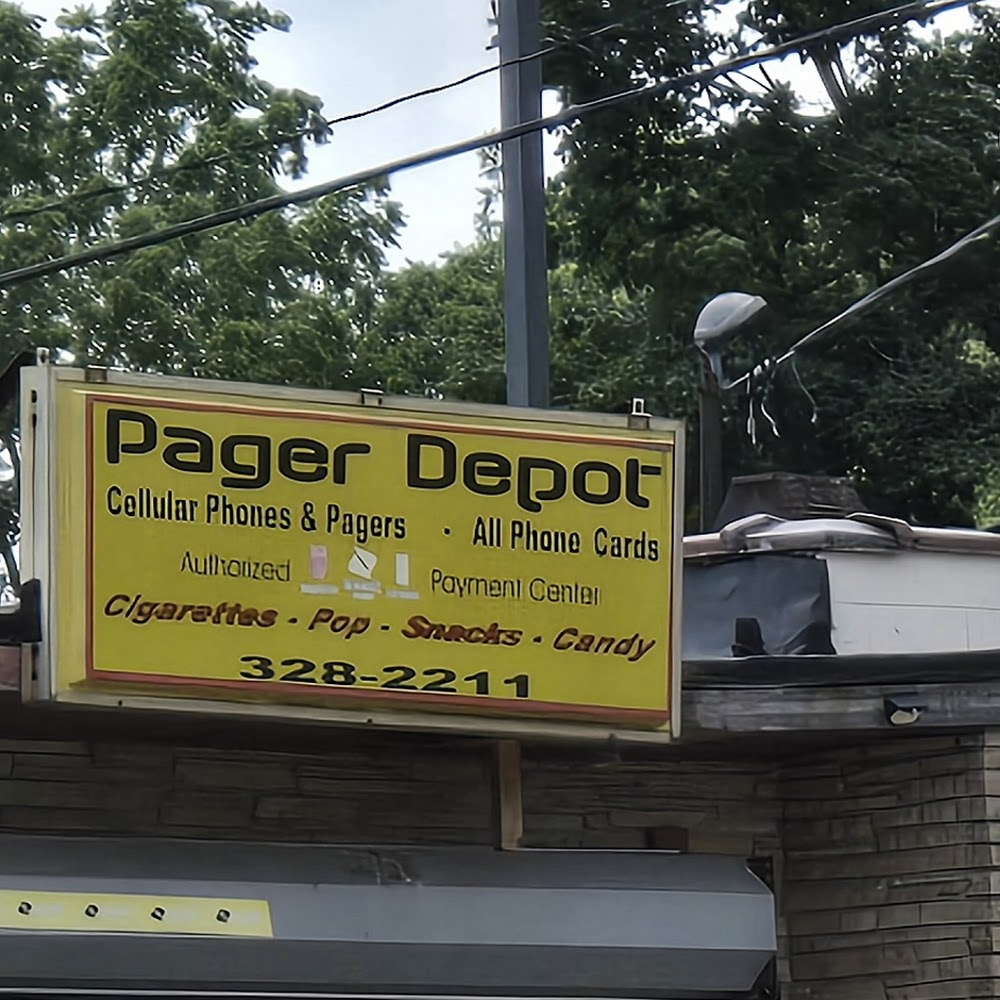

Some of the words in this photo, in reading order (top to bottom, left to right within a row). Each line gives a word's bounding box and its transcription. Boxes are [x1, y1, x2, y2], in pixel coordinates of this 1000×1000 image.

[106, 408, 371, 489] Pager
[406, 433, 663, 512] Depot
[106, 485, 197, 523] Cellular
[205, 493, 292, 531] Phones
[300, 504, 317, 532] &
[326, 504, 407, 544] Pagers
[472, 516, 502, 548] All
[509, 520, 581, 554] Phone
[593, 527, 659, 561] Cards
[181, 551, 290, 582] Authorized
[431, 568, 521, 598] Payment
[529, 577, 599, 606] Center
[104, 594, 279, 627] Cigarettes
[308, 608, 371, 639] Pop
[401, 615, 523, 646] Snacks
[553, 628, 656, 662] Candy
[239, 655, 529, 699] 328-2211
